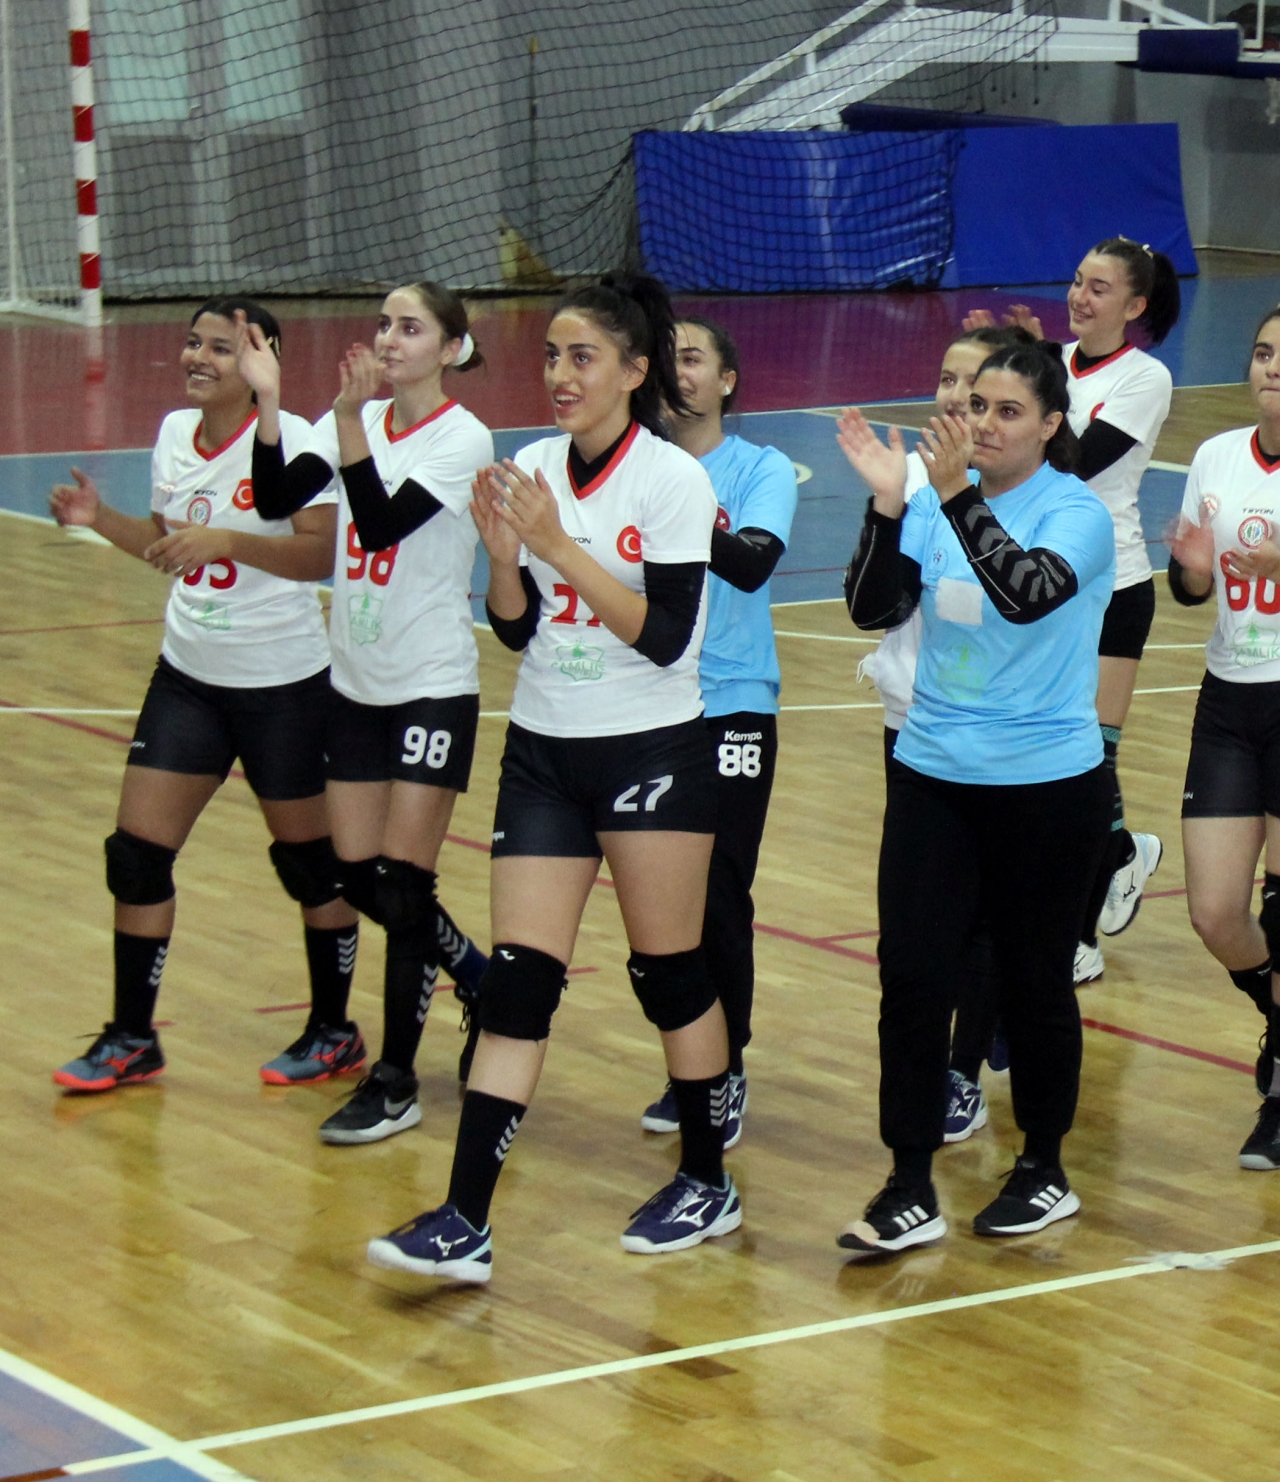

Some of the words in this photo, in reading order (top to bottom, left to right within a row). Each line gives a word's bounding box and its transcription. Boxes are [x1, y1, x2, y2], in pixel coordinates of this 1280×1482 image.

[550, 583, 602, 627] 2
[401, 725, 452, 769] 98
[724, 730, 763, 743] Kempa
[717, 744, 761, 778] 88
[613, 774, 674, 812] 27
